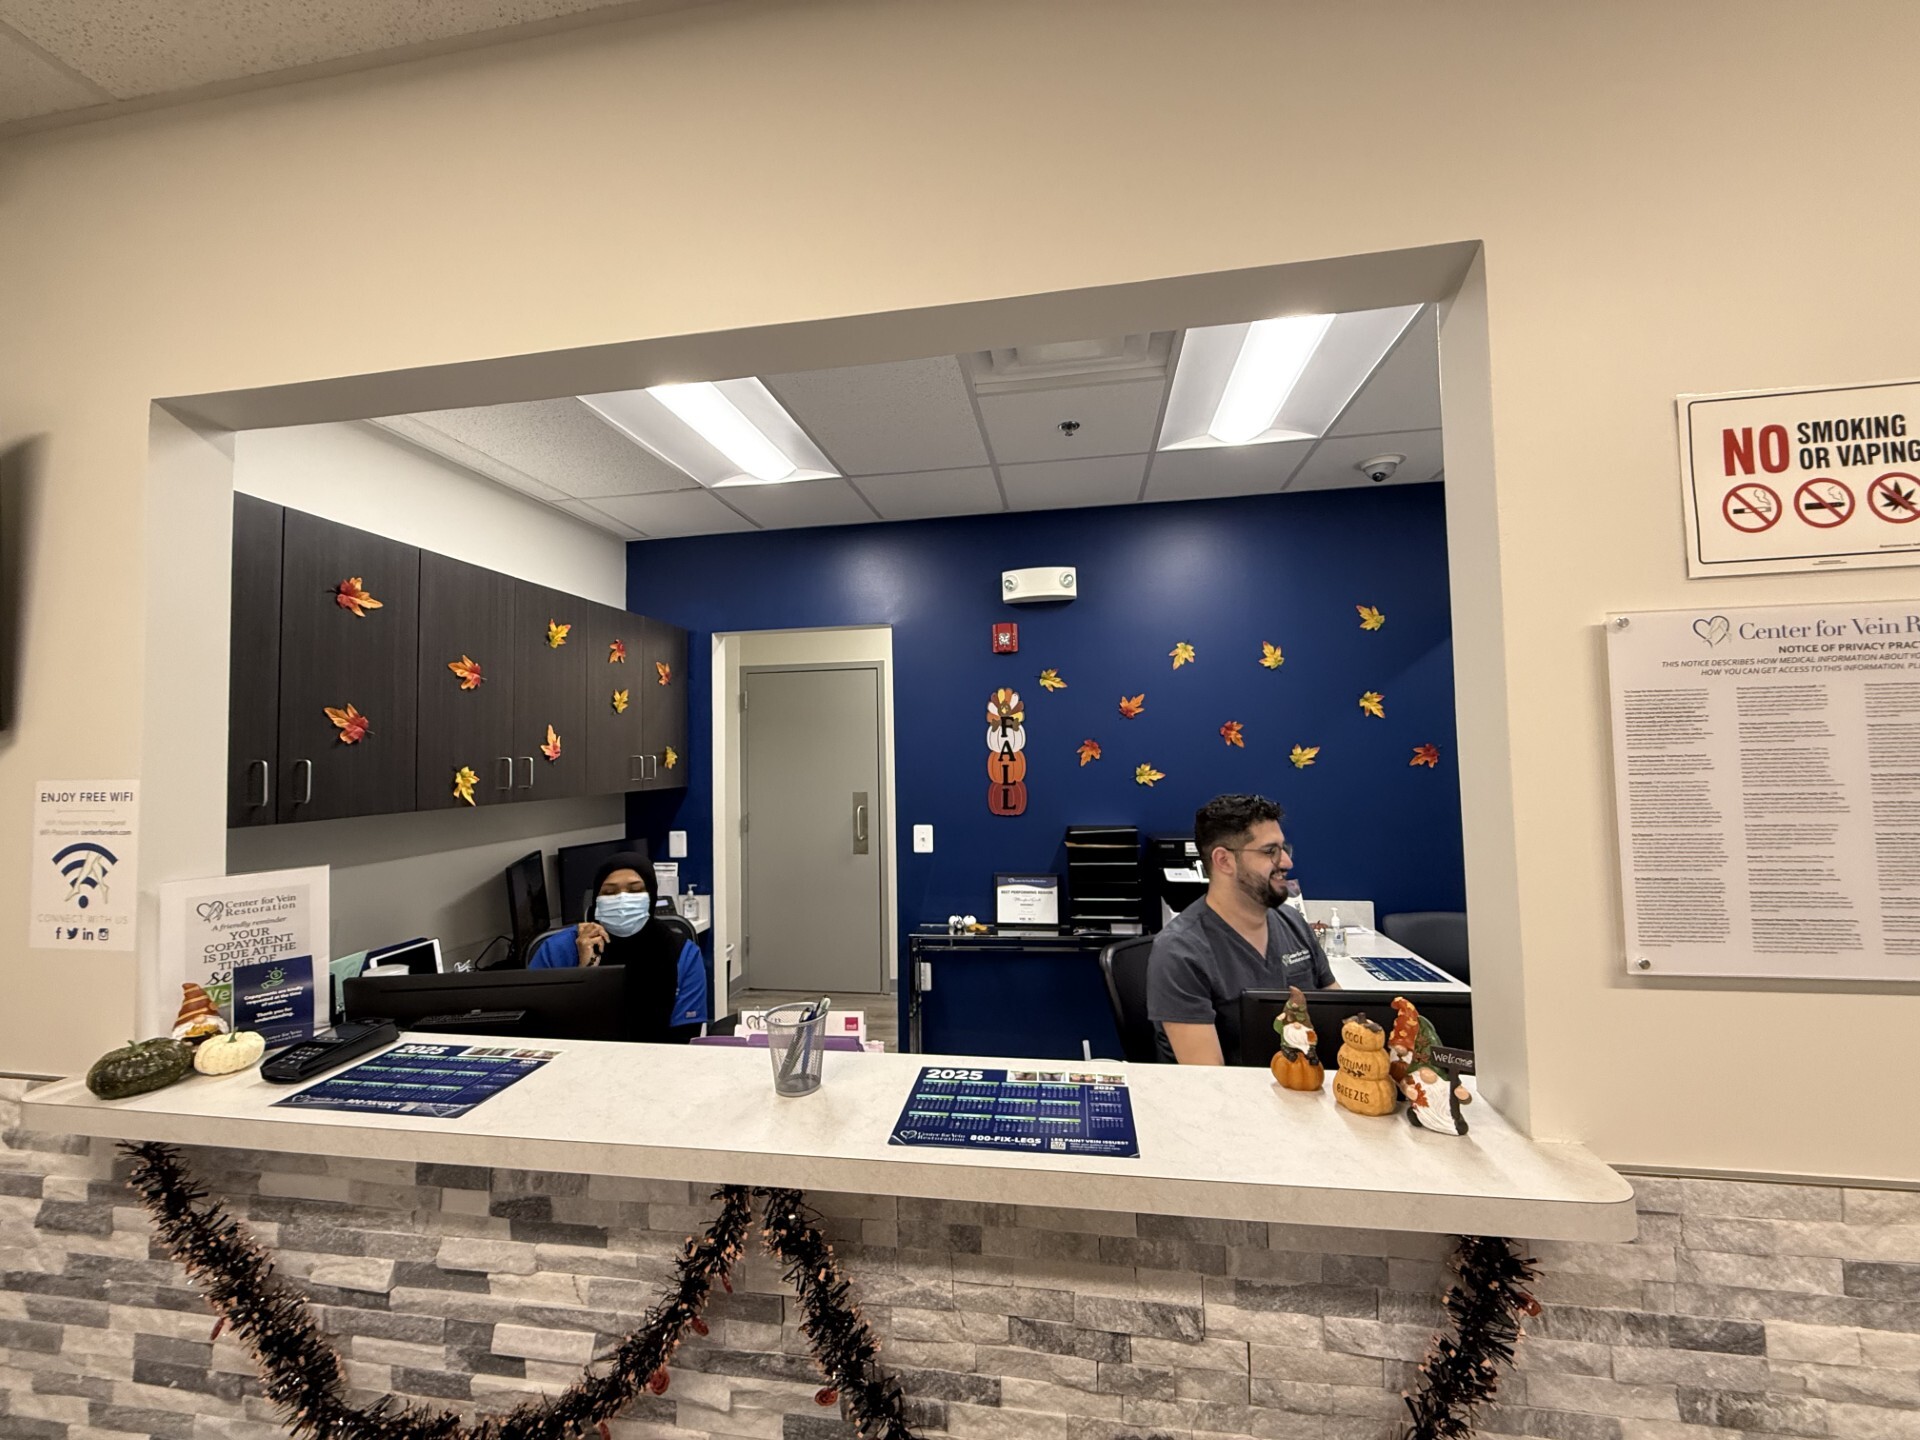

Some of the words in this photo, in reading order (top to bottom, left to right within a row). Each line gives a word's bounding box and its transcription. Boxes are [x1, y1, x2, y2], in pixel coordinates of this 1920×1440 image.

[1797, 414, 1907, 444] SMOKING
[1722, 424, 1790, 477] NO
[1799, 447, 1831, 470] OR
[1836, 439, 1920, 467] VAPING
[1739, 621, 1811, 640] Center
[1815, 619, 1847, 638] for
[1851, 617, 1900, 636] Vein
[1779, 644, 1819, 654] NOTICE
[1821, 643, 1836, 652] OF
[1838, 642, 1886, 651] PRIVACY
[1888, 640, 1920, 650] PRAC
[1681, 659, 1710, 668] NOTICE
[1711, 658, 1755, 667] DESCRIBES
[1756, 657, 1778, 665] HOW
[1779, 655, 1816, 664] MEDICAL
[1817, 653, 1879, 663] INFORMATION
[1879, 652, 1909, 661] ABOUT
[1701, 668, 1722, 676] HOW
[1742, 667, 1760, 675] CAN
[1761, 666, 1778, 674] GET
[1779, 665, 1810, 673] ACCESS
[998, 716, 1017, 810] FALL
[41, 792, 76, 803] ENJOY
[79, 792, 107, 802] FREE
[110, 791, 134, 802] WIFI
[225, 899, 259, 910] Center
[261, 896, 274, 905] for
[276, 894, 297, 904] Vein
[225, 902, 297, 917] Restoration
[37, 914, 83, 924] CONNECT
[115, 915, 129, 925] US
[211, 924, 219, 932] A
[218, 920, 251, 931] friendly
[251, 916, 288, 927] reminder
[229, 927, 271, 941] YOUR
[204, 933, 294, 954] COPAYMENT
[203, 954, 217, 964] IS
[220, 951, 250, 962] DUE
[252, 946, 271, 956] AT
[272, 942, 297, 953] THE
[218, 958, 255, 971] TIME
[258, 954, 277, 964] OF
[1344, 1030, 1363, 1045] COOL
[395, 1044, 449, 1055] 2025
[1339, 1055, 1371, 1072] AUTUMN
[1432, 1051, 1474, 1068] Welcome
[925, 1068, 984, 1081] 2025
[1336, 1083, 1370, 1105] BREEZES
[970, 1134, 1042, 1145] 800-FIX-LEGS
